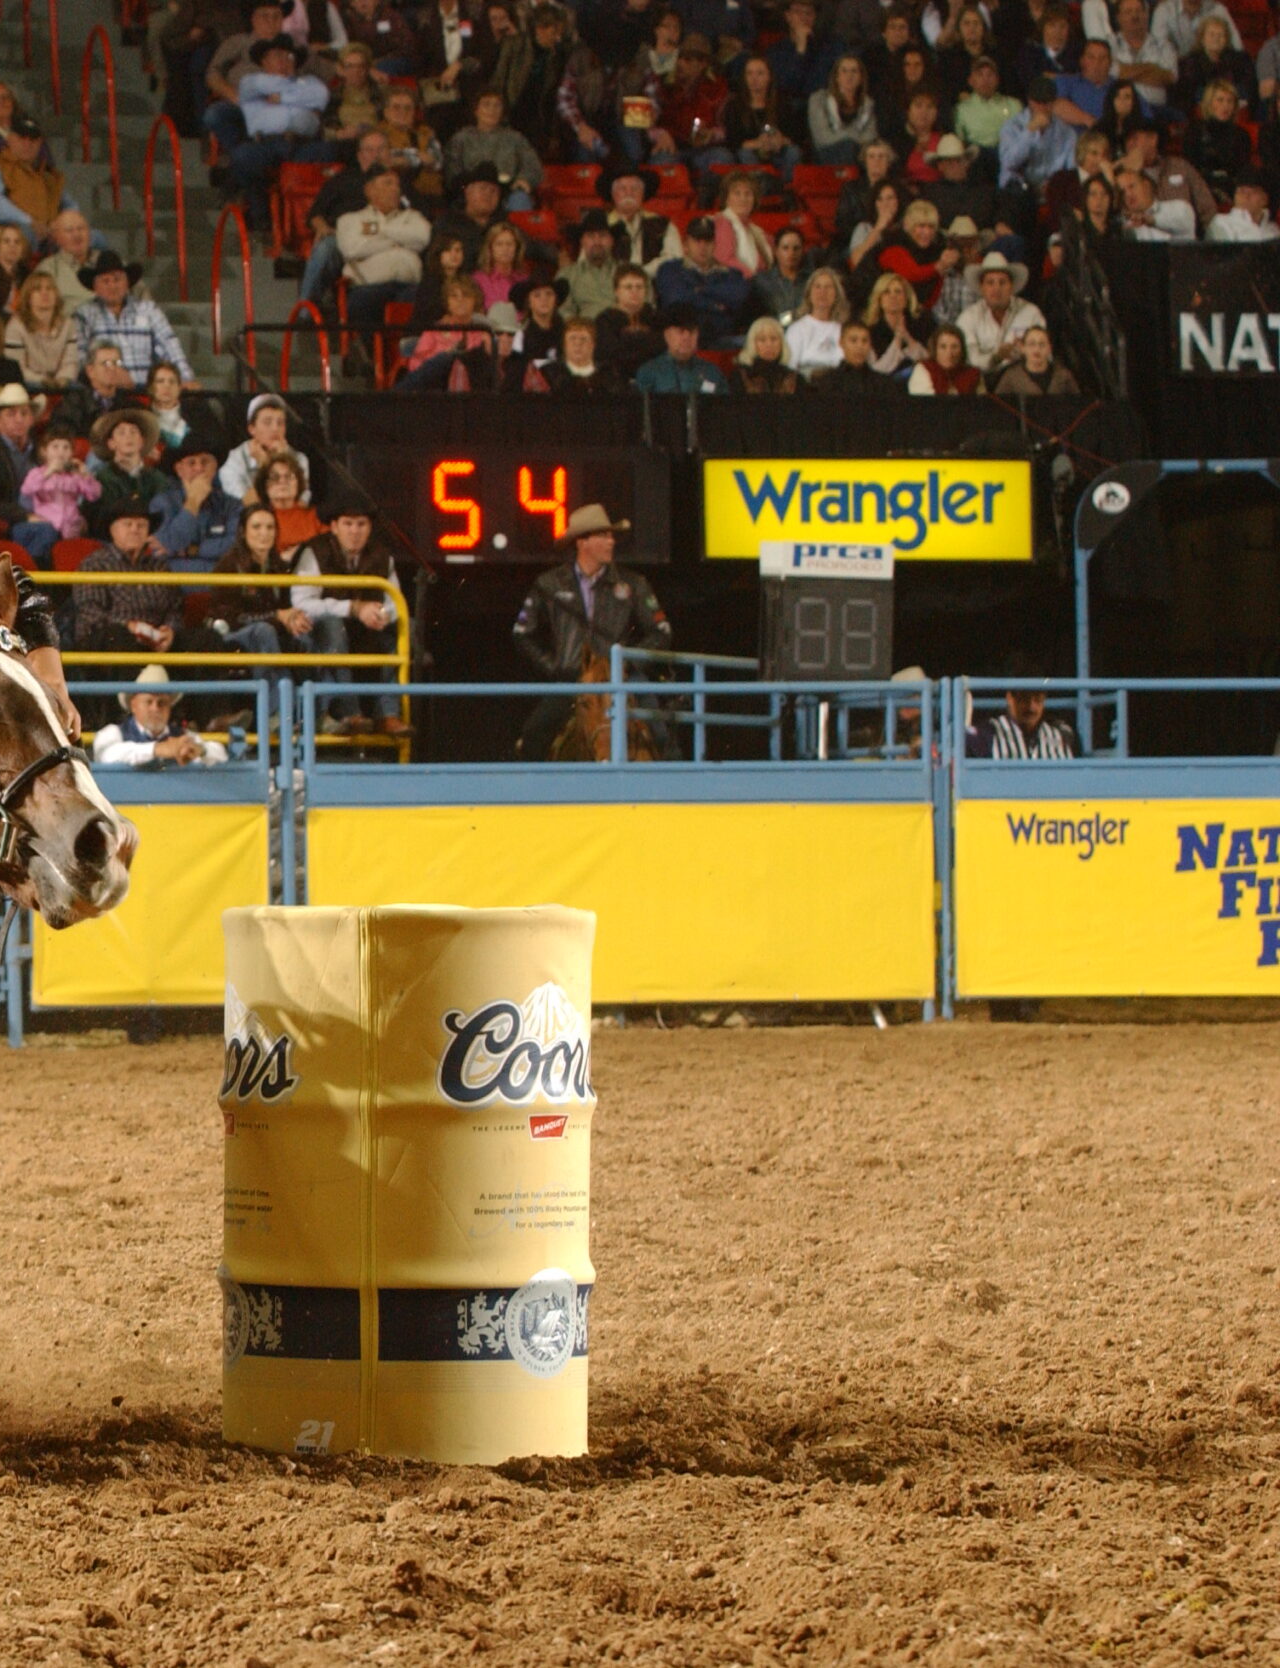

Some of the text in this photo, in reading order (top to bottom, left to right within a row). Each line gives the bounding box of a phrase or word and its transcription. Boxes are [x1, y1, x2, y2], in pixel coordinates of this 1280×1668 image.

[733, 469, 1004, 551] Wrangler
[793, 543, 883, 567] prca
[1006, 811, 1129, 861] Wrangler
[1218, 871, 1280, 918] FI
[441, 1002, 595, 1102] Coor
[474, 1207, 505, 1215] Brewed
[297, 1420, 335, 1447] 21
